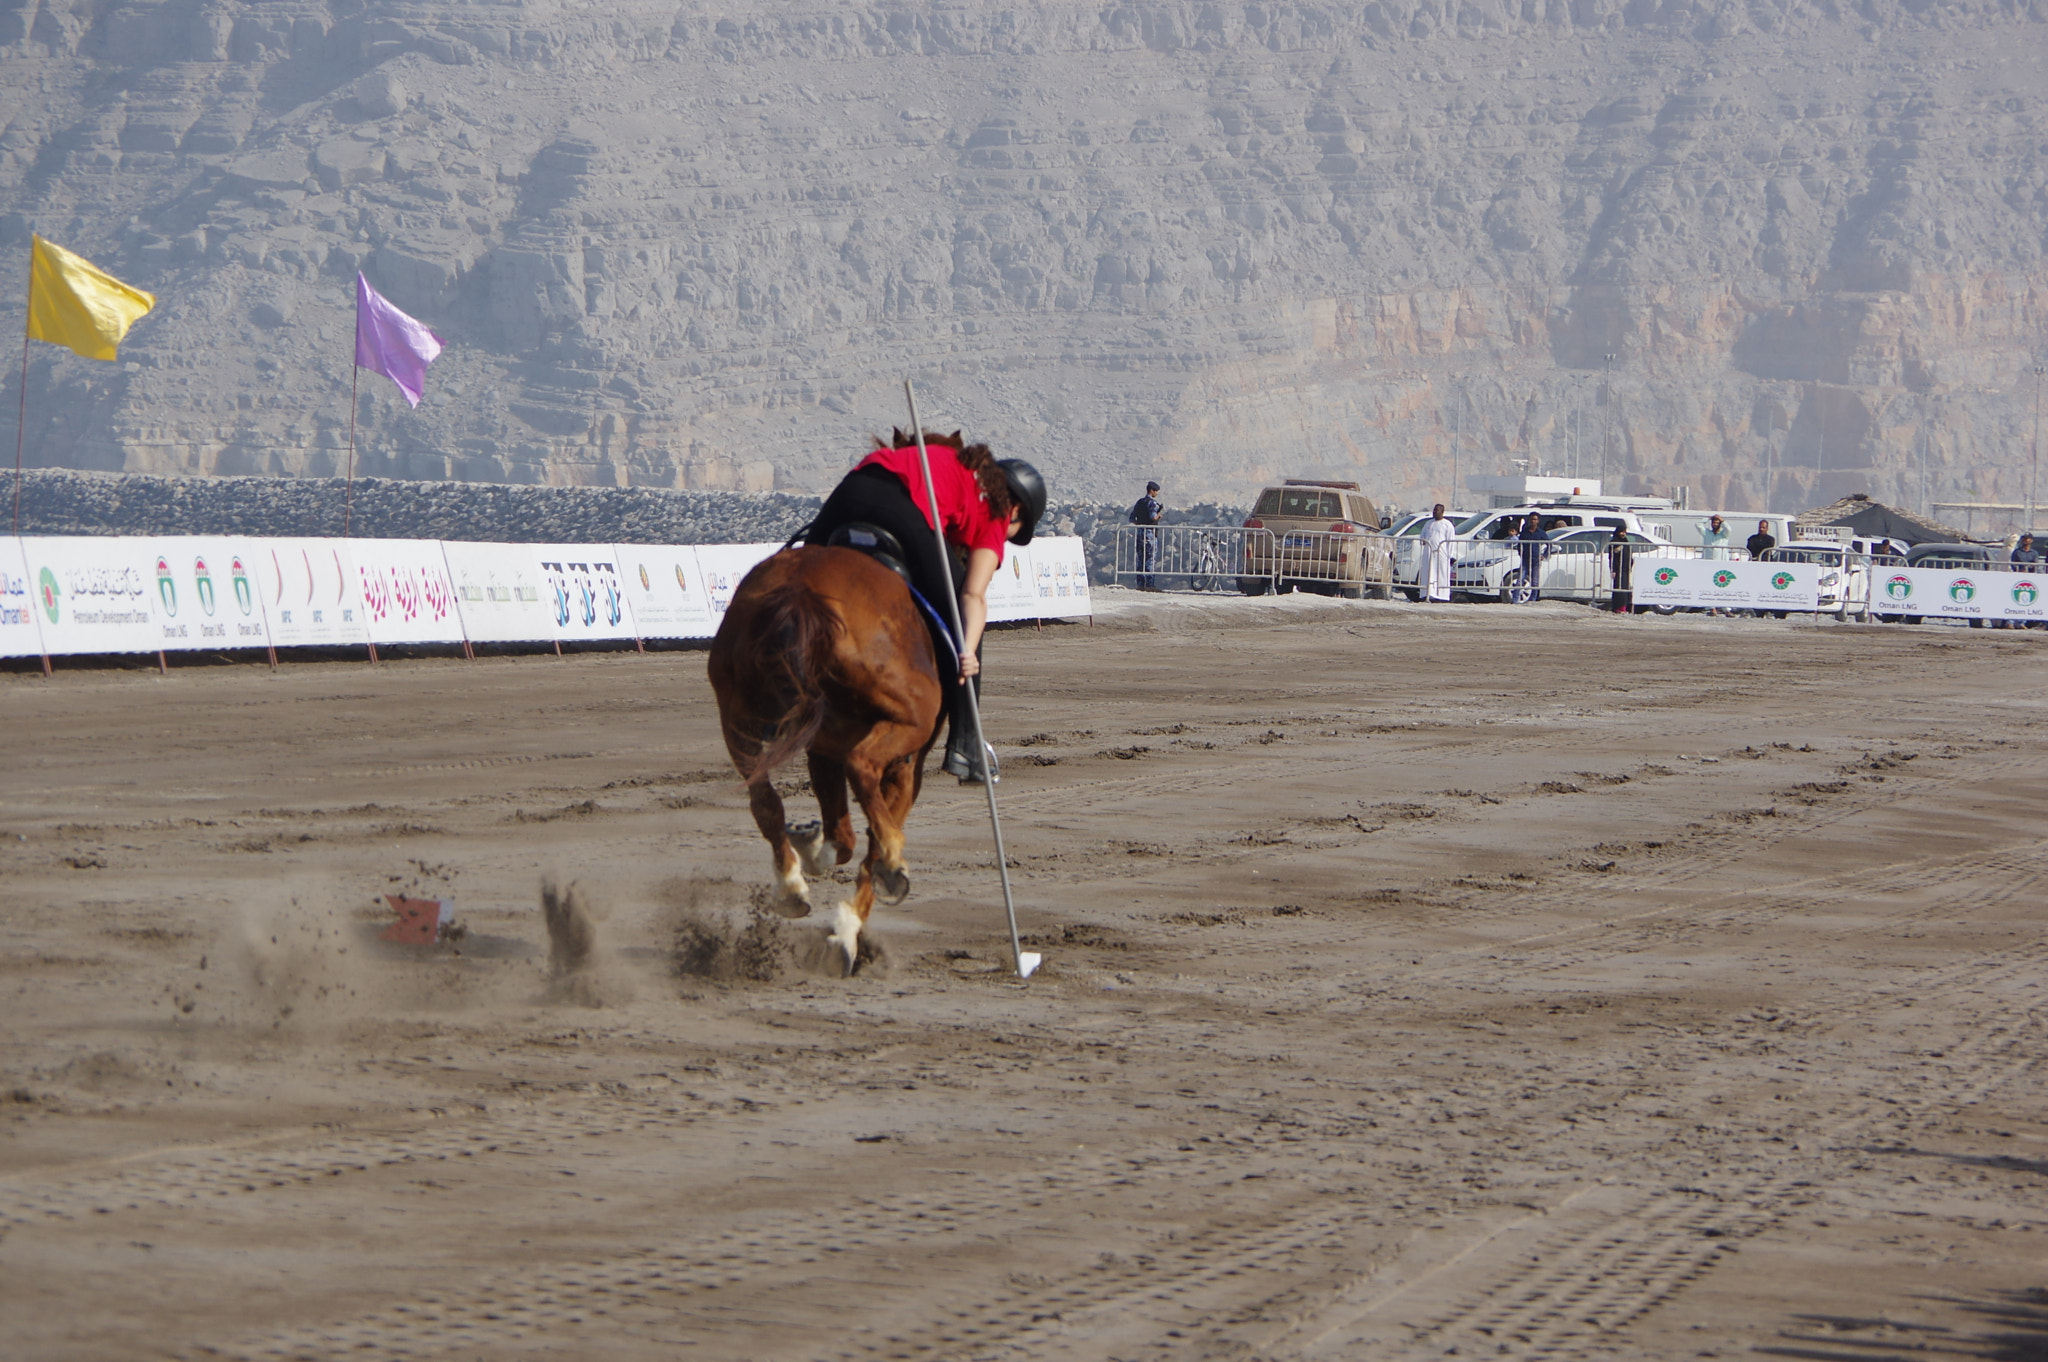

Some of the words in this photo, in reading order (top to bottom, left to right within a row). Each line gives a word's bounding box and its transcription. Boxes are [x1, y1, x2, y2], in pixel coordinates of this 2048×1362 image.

[1879, 601, 1900, 610] Oman
[1902, 603, 1918, 611] LNG
[1941, 605, 1963, 613] Oman
[1965, 606, 1981, 614] LNG
[2004, 607, 2026, 616] Oman
[2027, 609, 2044, 617] LNG
[132, 609, 150, 624] Oman
[163, 625, 177, 638] Oman
[176, 624, 188, 638] LNG
[201, 623, 214, 637] Oman
[214, 623, 226, 637] LNG
[237, 623, 251, 636] Oman
[250, 623, 262, 636] LNG
